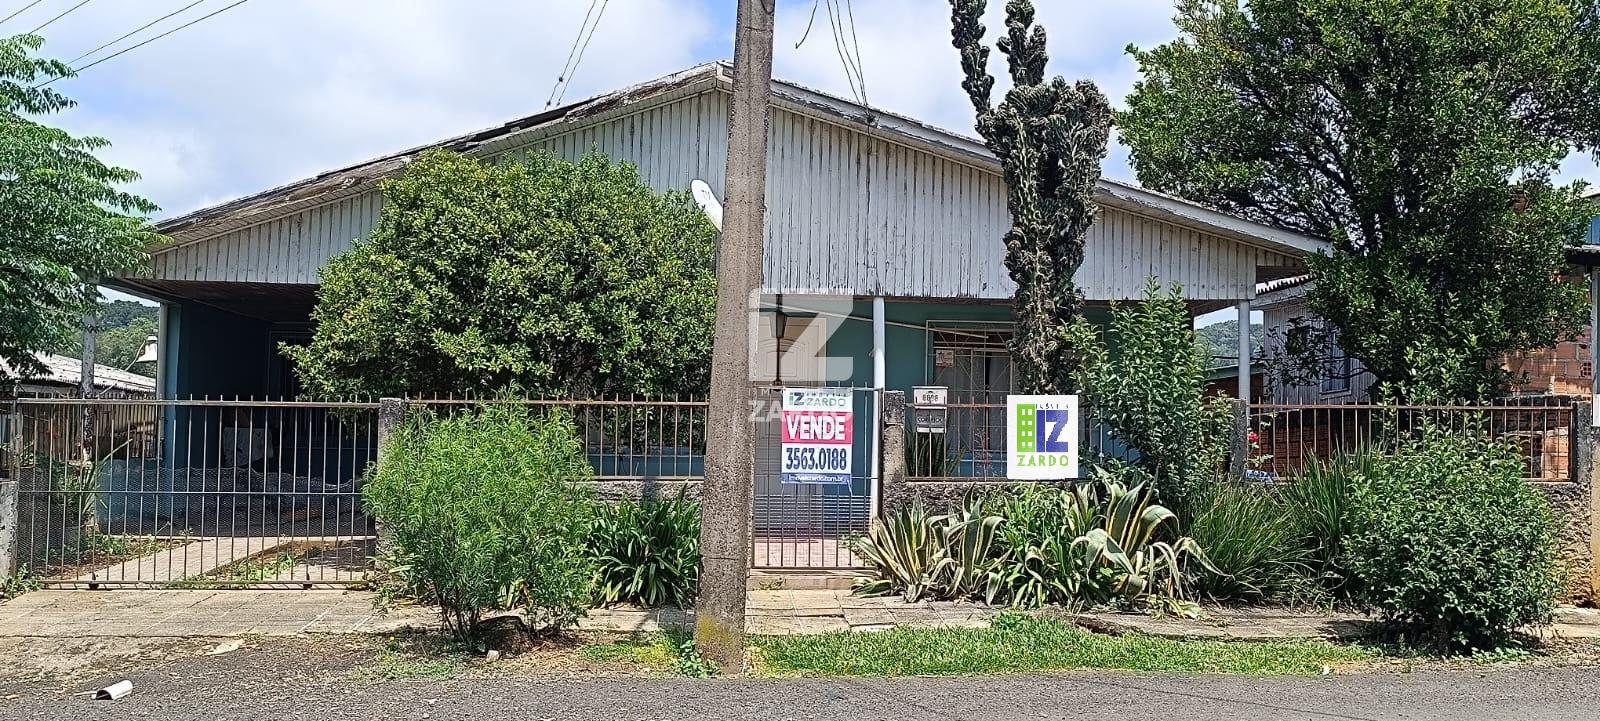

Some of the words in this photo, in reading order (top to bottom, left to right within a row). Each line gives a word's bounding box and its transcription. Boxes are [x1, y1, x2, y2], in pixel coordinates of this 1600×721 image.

[807, 397, 846, 406] ZARDO
[785, 416, 846, 440] VENDE
[786, 447, 847, 471] 3563.0188
[1017, 455, 1069, 467] ZARDO
